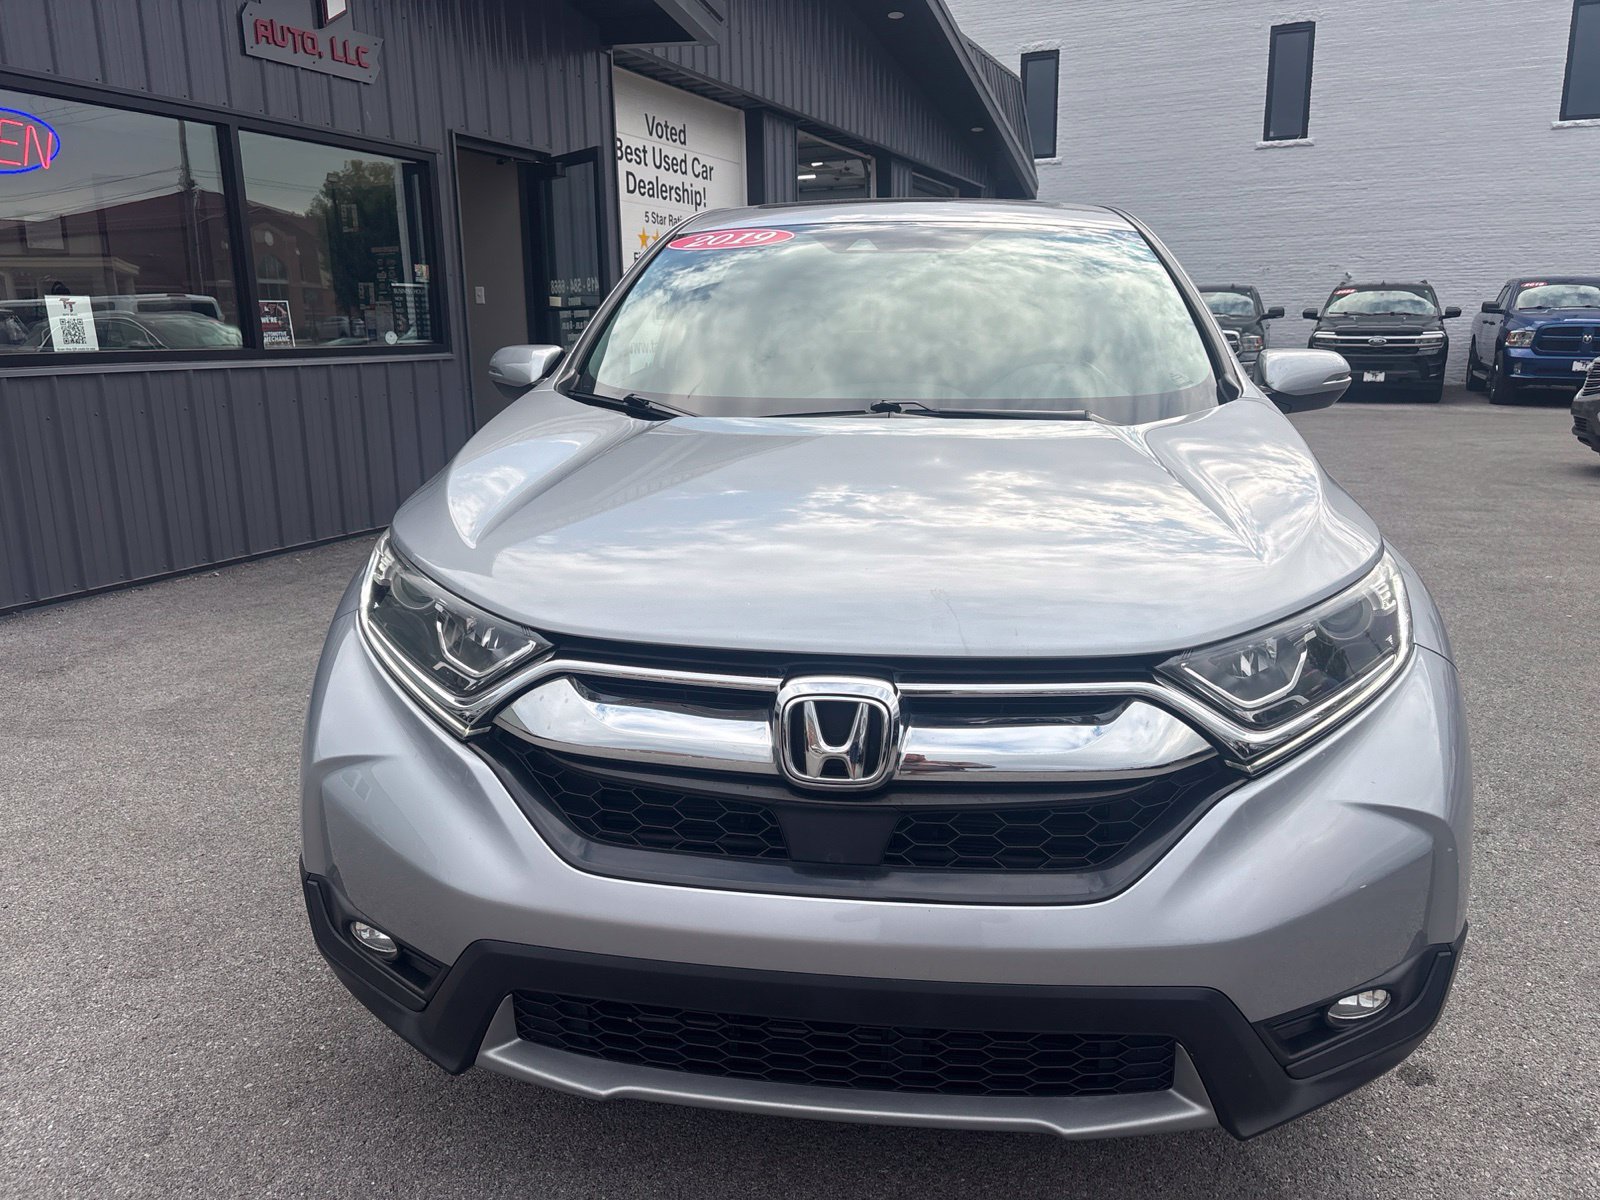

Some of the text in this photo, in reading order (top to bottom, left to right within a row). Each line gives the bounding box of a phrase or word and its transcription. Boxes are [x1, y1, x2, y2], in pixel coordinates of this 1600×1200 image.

[254, 19, 370, 69] AUTO, LLC
[644, 113, 687, 146] Voted
[616, 137, 714, 181] Best Used Car
[625, 170, 706, 212] Dealership!
[644, 211, 650, 224] 5
[651, 211, 667, 226] Star
[683, 231, 778, 248] 2019
